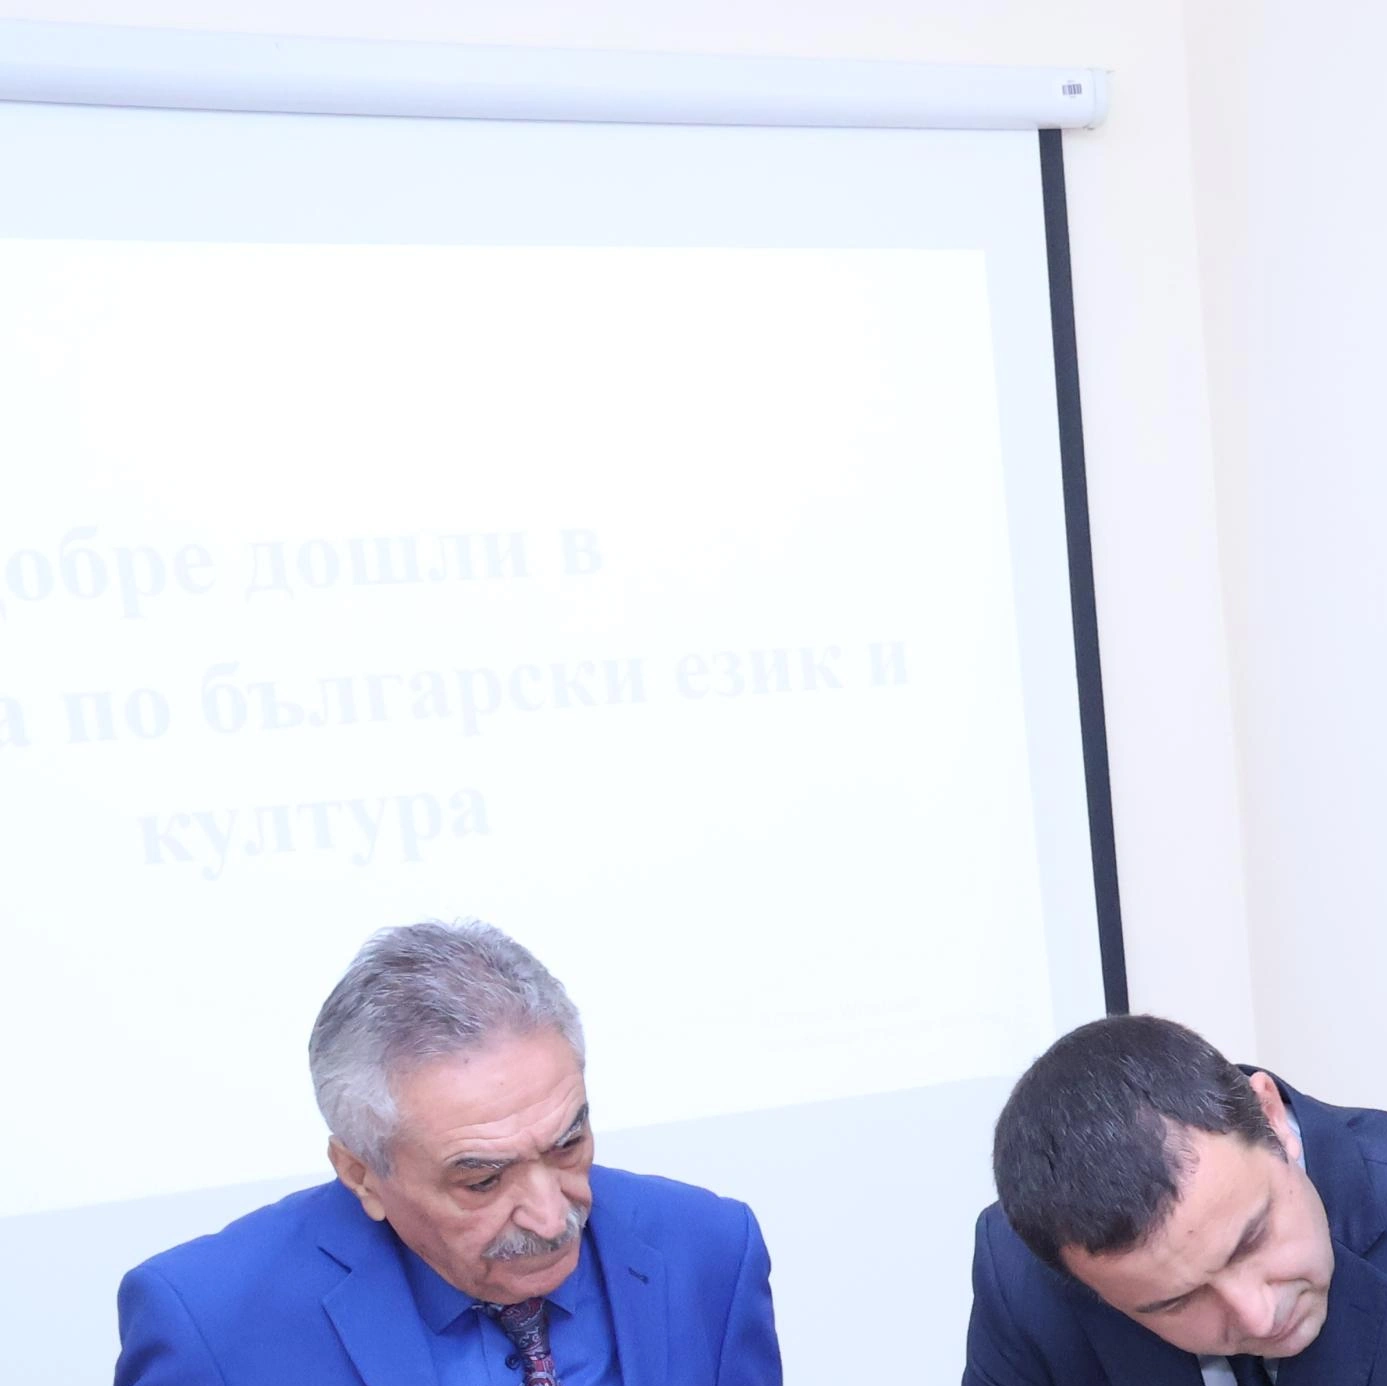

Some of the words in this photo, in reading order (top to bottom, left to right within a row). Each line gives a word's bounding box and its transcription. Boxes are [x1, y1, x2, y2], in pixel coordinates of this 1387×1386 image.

[0, 524, 216, 620] обре
[244, 528, 531, 601] дошли
[559, 526, 606, 577] в
[62, 686, 171, 745] по
[200, 655, 649, 739] български
[673, 641, 844, 702] език
[867, 638, 912, 689] и
[140, 784, 495, 882] култура
